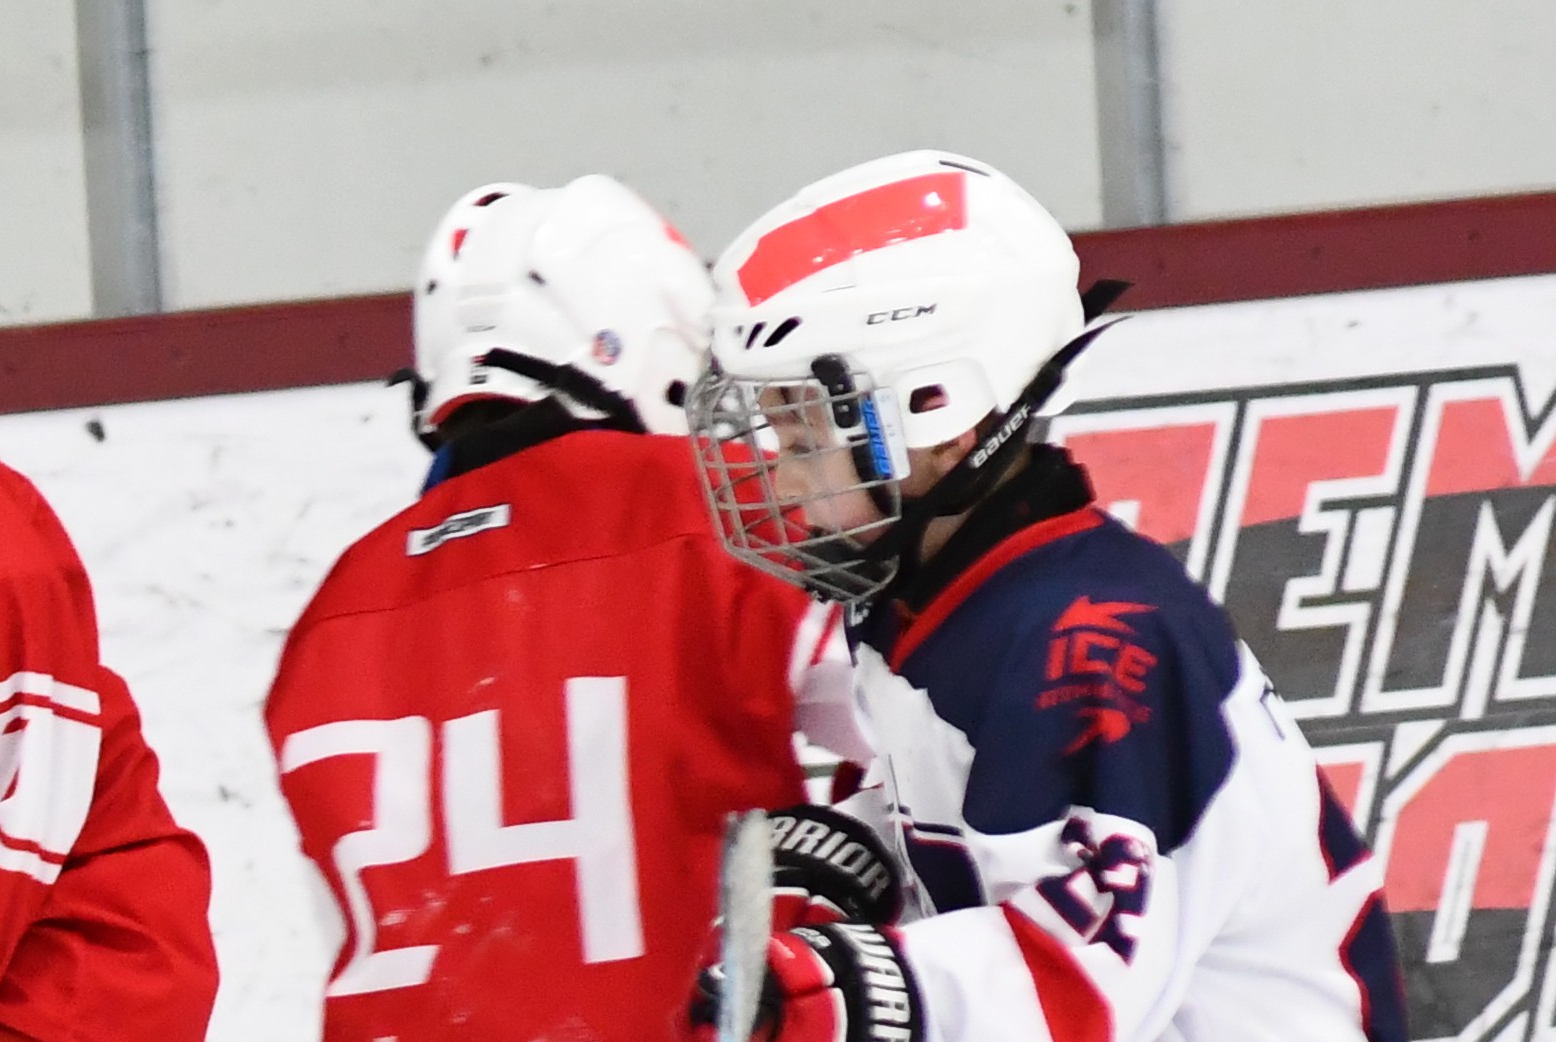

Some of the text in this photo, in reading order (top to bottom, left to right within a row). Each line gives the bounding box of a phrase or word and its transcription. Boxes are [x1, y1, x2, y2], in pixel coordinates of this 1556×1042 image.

[865, 303, 938, 326] CCM
[1045, 630, 1159, 694] ICE
[280, 674, 647, 998] 24
